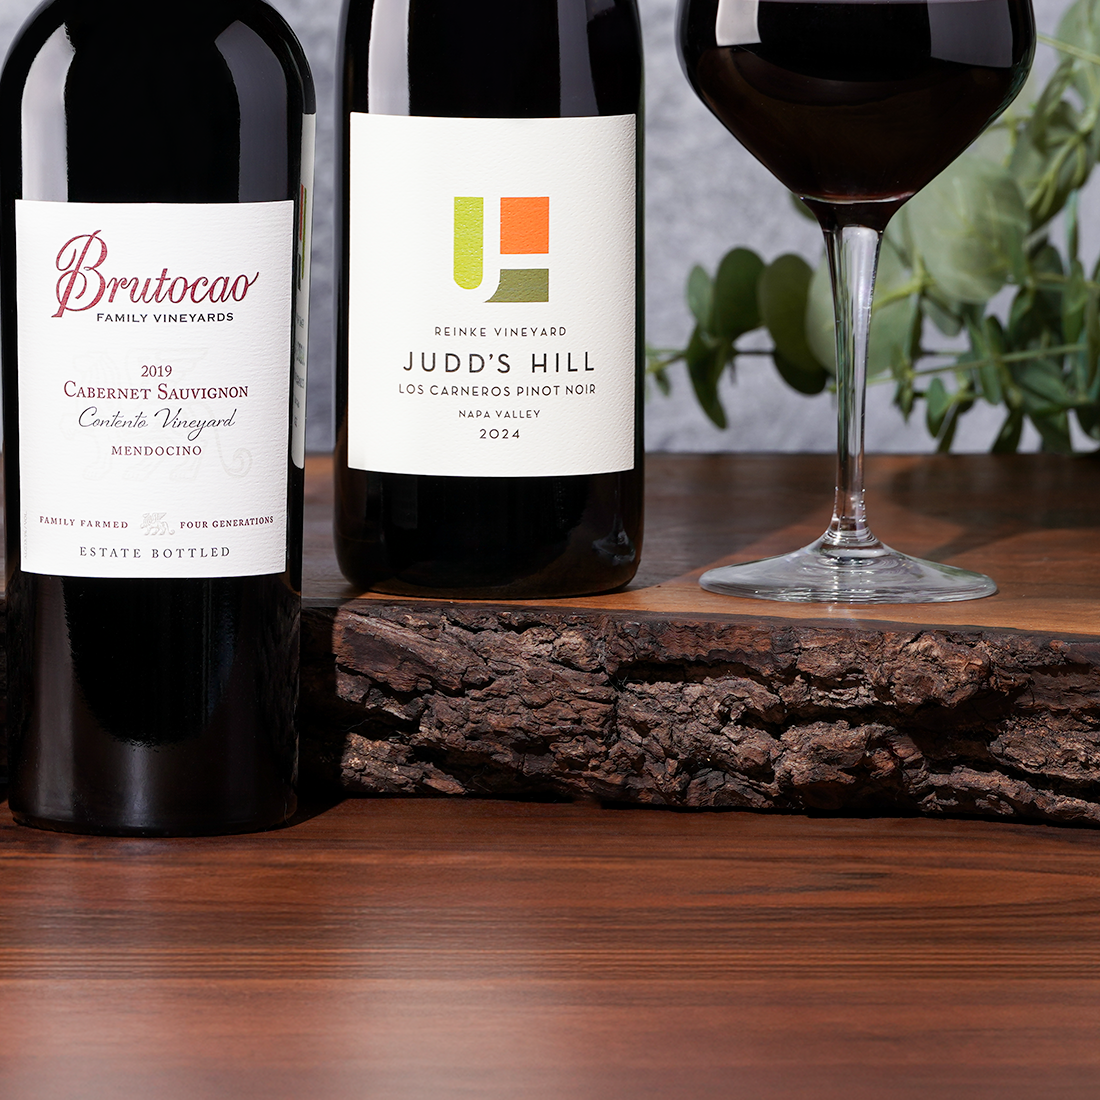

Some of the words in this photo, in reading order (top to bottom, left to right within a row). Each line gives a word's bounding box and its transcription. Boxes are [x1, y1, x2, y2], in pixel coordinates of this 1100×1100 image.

[52, 230, 259, 318] Brutocao
[97, 313, 147, 322] FAMILY
[154, 313, 233, 322] VINEYARDS
[435, 327, 486, 337] REINKE
[494, 327, 566, 336] VINEYARD
[403, 352, 510, 373] JUDD’S
[532, 352, 594, 373] HILL
[141, 365, 172, 377] 2019
[399, 384, 424, 394] LOS
[430, 385, 510, 396] CARNEROS
[517, 386, 560, 396] PINOT
[566, 384, 595, 395] NOIR
[459, 410, 490, 418] NAPA
[496, 410, 540, 418] VALLEY
[78, 407, 148, 428] Contento
[154, 408, 235, 441] Vineyard
[480, 429, 519, 439] 2024
[112, 446, 201, 456] MENDOCINO
[40, 516, 75, 526] FAMILY
[81, 520, 128, 528] FARMED
[212, 516, 273, 528] GENERATIONS
[80, 547, 140, 558] ESTATE
[152, 547, 229, 558] BOTTLED
